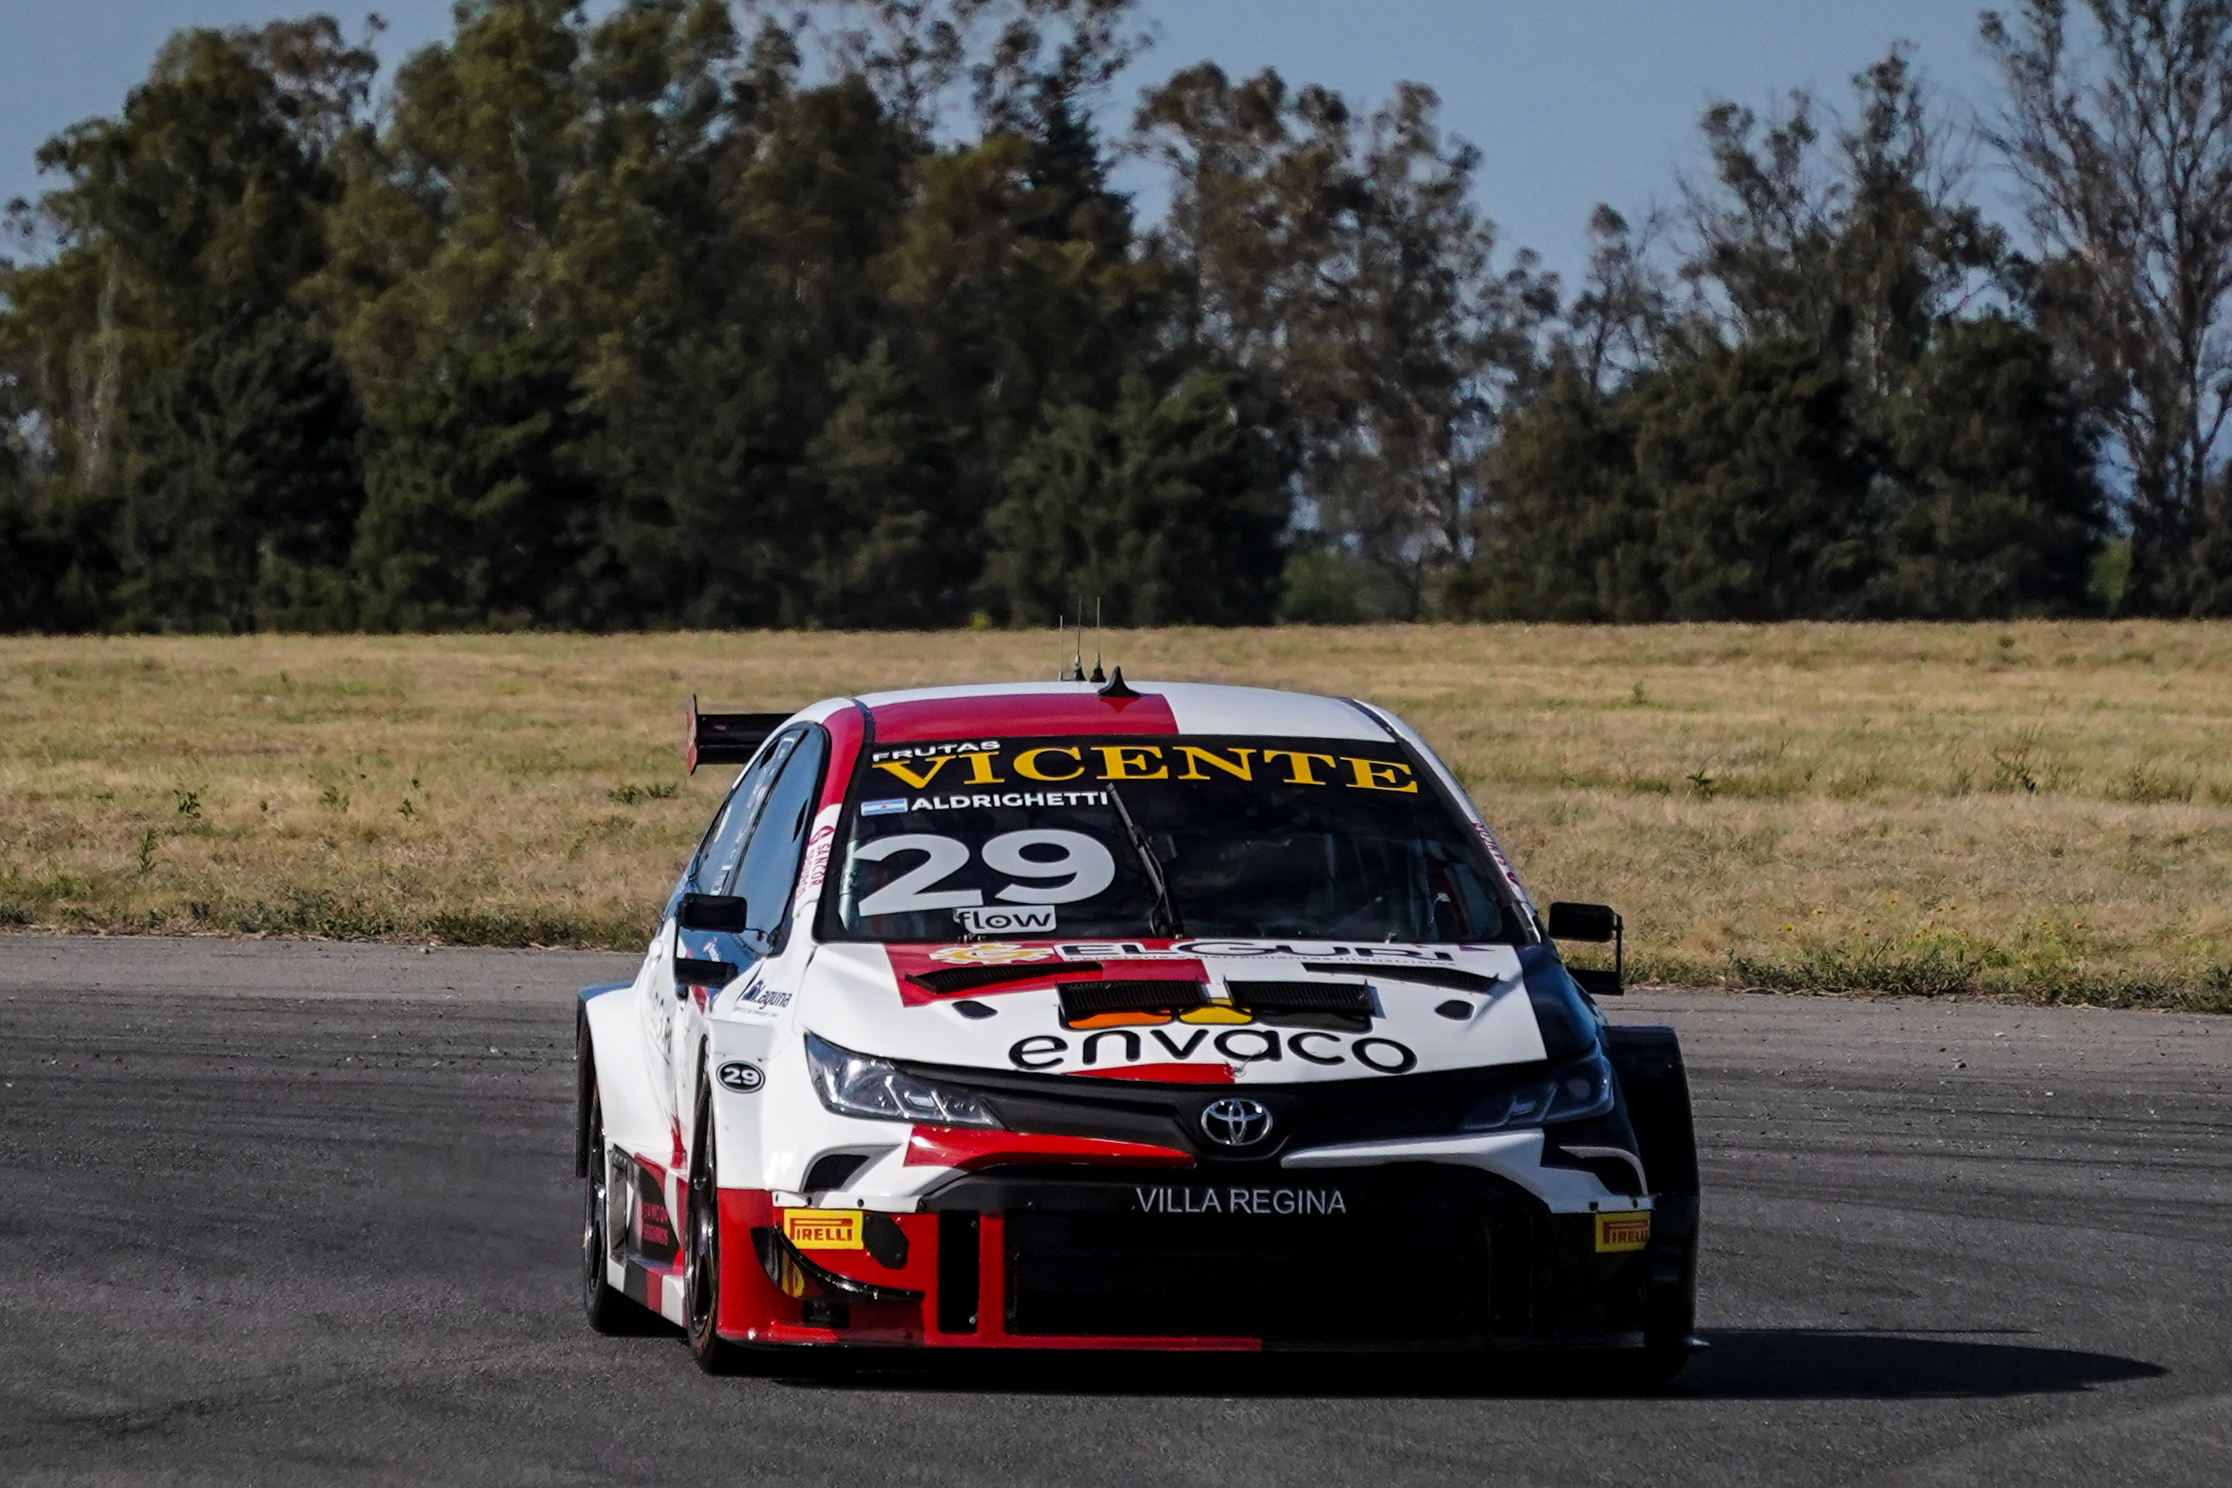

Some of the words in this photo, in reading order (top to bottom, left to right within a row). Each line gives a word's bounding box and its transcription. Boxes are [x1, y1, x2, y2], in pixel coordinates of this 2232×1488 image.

[872, 740, 1001, 763] FRUTAS
[872, 745, 1418, 794] VICENTE
[911, 790, 1108, 811] ALDRIGHETTI
[853, 829, 1116, 917] 29
[959, 908, 1052, 934] flow
[1009, 1028, 1418, 1074] envaco
[723, 1068, 760, 1084] 29
[1137, 1187, 1223, 1213] VILLA
[1231, 1189, 1347, 1214] REGINA
[789, 1218, 854, 1241] PIRELLI
[1602, 1220, 1649, 1245] PIRELLI
